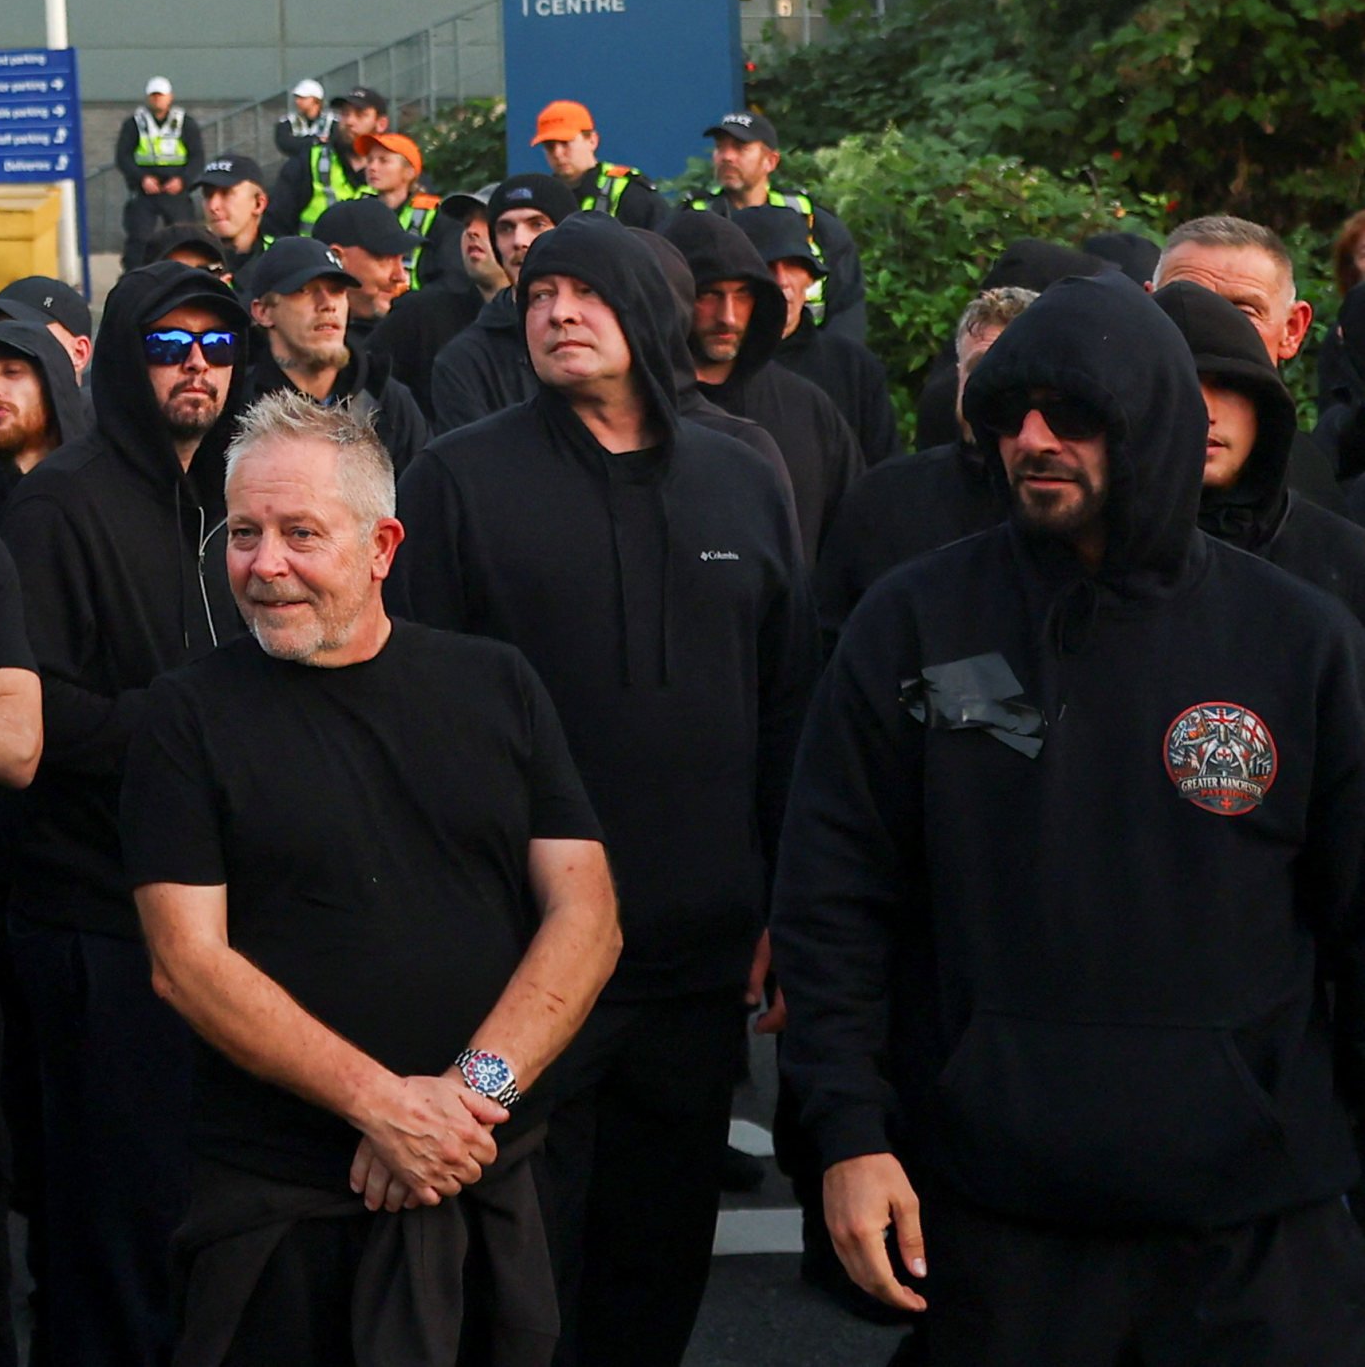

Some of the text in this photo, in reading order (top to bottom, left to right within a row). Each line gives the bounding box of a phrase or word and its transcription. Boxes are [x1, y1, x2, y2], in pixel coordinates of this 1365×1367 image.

[10, 53, 46, 67] parking
[11, 80, 47, 93] parking
[12, 106, 49, 120] parking
[13, 132, 50, 146] parking
[1181, 777, 1263, 795] GREATER MANCHESTER
